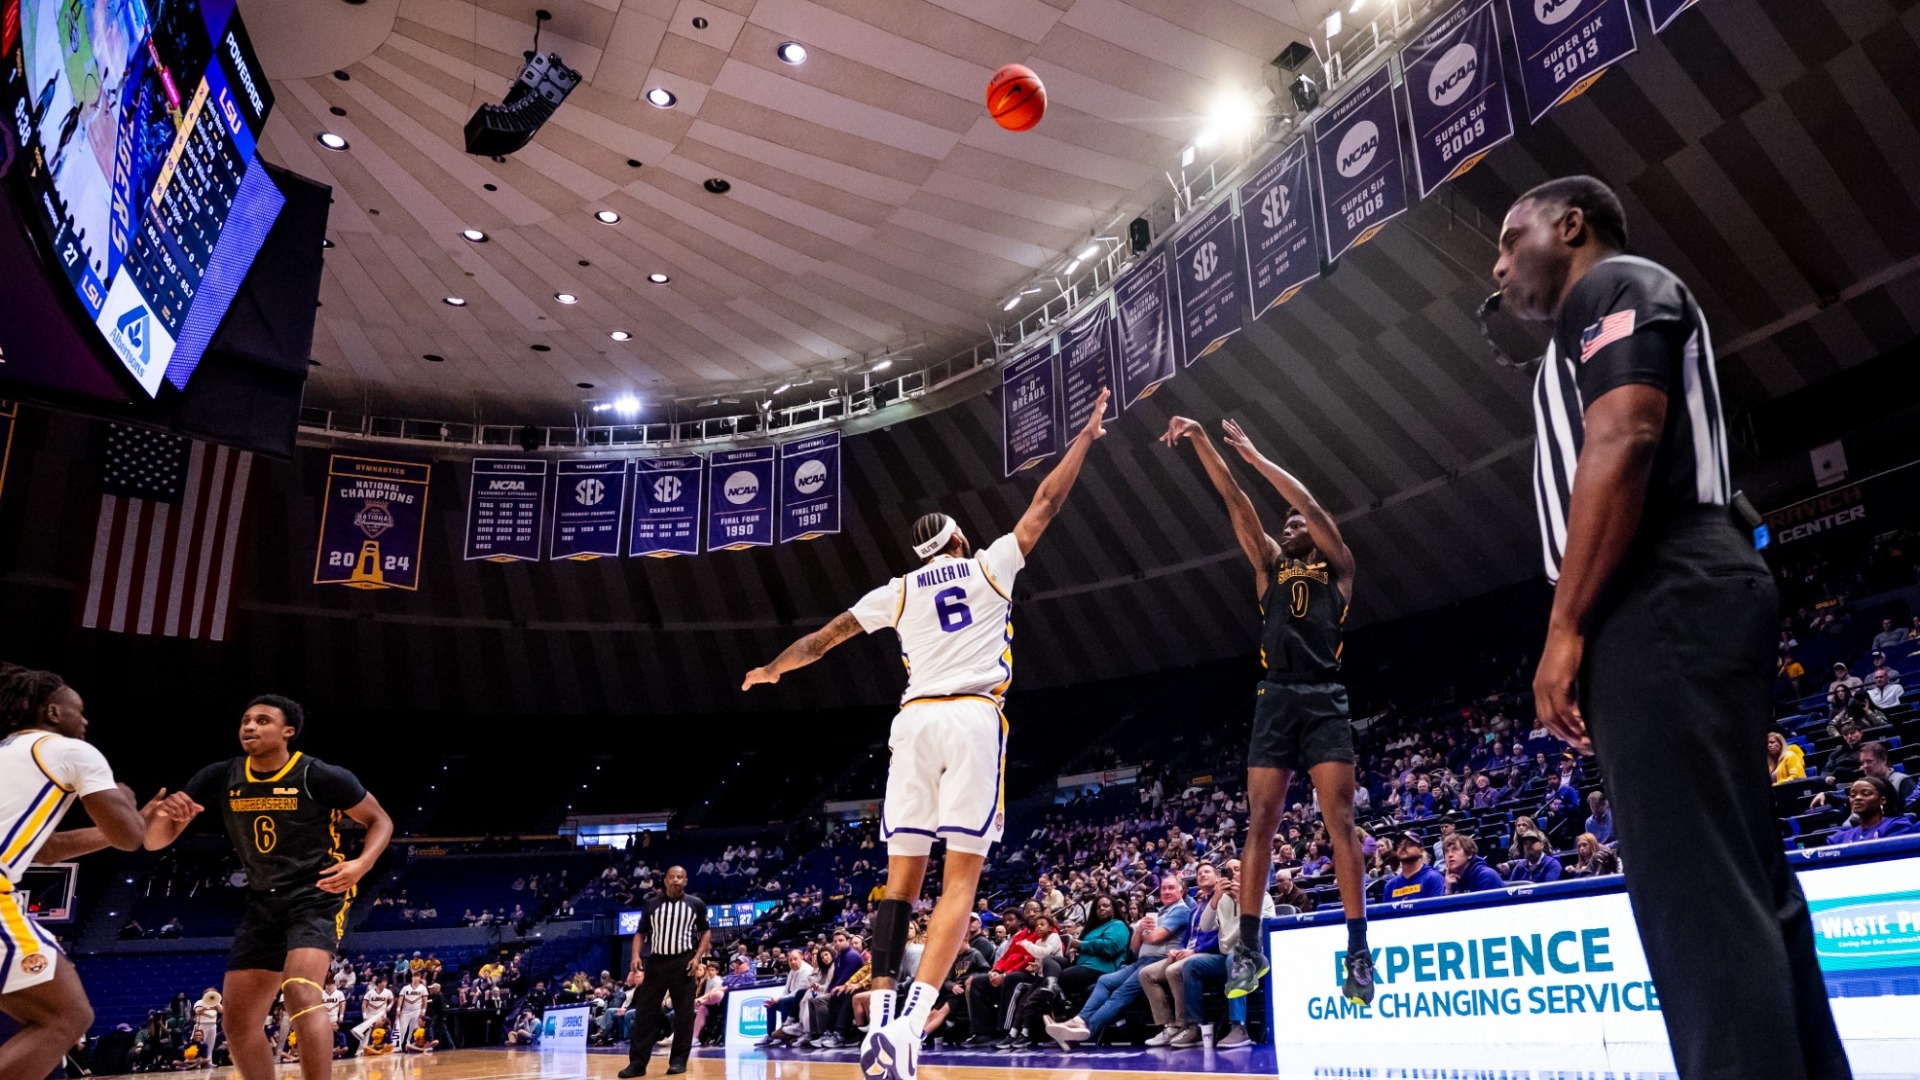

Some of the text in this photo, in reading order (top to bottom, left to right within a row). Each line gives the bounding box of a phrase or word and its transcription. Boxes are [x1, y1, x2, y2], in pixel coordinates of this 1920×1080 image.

[1543, 16, 1603, 69] SUPER SIX
[226, 31, 263, 118] POWERADE
[1553, 37, 1599, 84] 2013
[1435, 57, 1477, 100] NCAA
[15, 97, 31, 147] 9:38
[219, 87, 242, 135] LSU
[1434, 100, 1487, 147] SUPER SIX
[1342, 135, 1378, 172] NCAA
[1441, 118, 1486, 162] 2009
[1261, 184, 1291, 229] SEC
[1341, 176, 1387, 215] SUPER SIX
[1346, 192, 1384, 230] 2008
[1261, 218, 1297, 250] CHAMPIONS
[63, 242, 79, 268] 27
[1193, 241, 1218, 281] SEC
[81, 275, 102, 310] LSU
[109, 328, 145, 378] Albertsons
[1012, 384, 1045, 412] BREAUX
[355, 464, 405, 475] GYMNASTICS
[489, 480, 525, 491] NCAA
[798, 473, 825, 487] NCAA
[340, 488, 414, 504] CHAMPIONS
[356, 481, 400, 492] NATIONAL
[575, 478, 605, 506] SEC
[654, 475, 682, 503] SEC
[728, 486, 757, 497] NCAA
[720, 514, 760, 526] FINAL FOUR
[792, 502, 828, 516] FINAL FOUR
[798, 512, 821, 527] 1991
[1779, 504, 1867, 544] CENTER
[726, 524, 754, 538] 1990
[329, 551, 355, 567] 20
[384, 555, 410, 571] 24
[917, 563, 970, 588] MILLER III
[934, 586, 973, 633] 6
[1290, 580, 1309, 618] 0
[254, 815, 277, 853] 6
[739, 914, 752, 925] 27
[1820, 914, 1891, 940] WASTE
[1308, 993, 1373, 1020] GAME
[1379, 987, 1522, 1019] CHANGING
